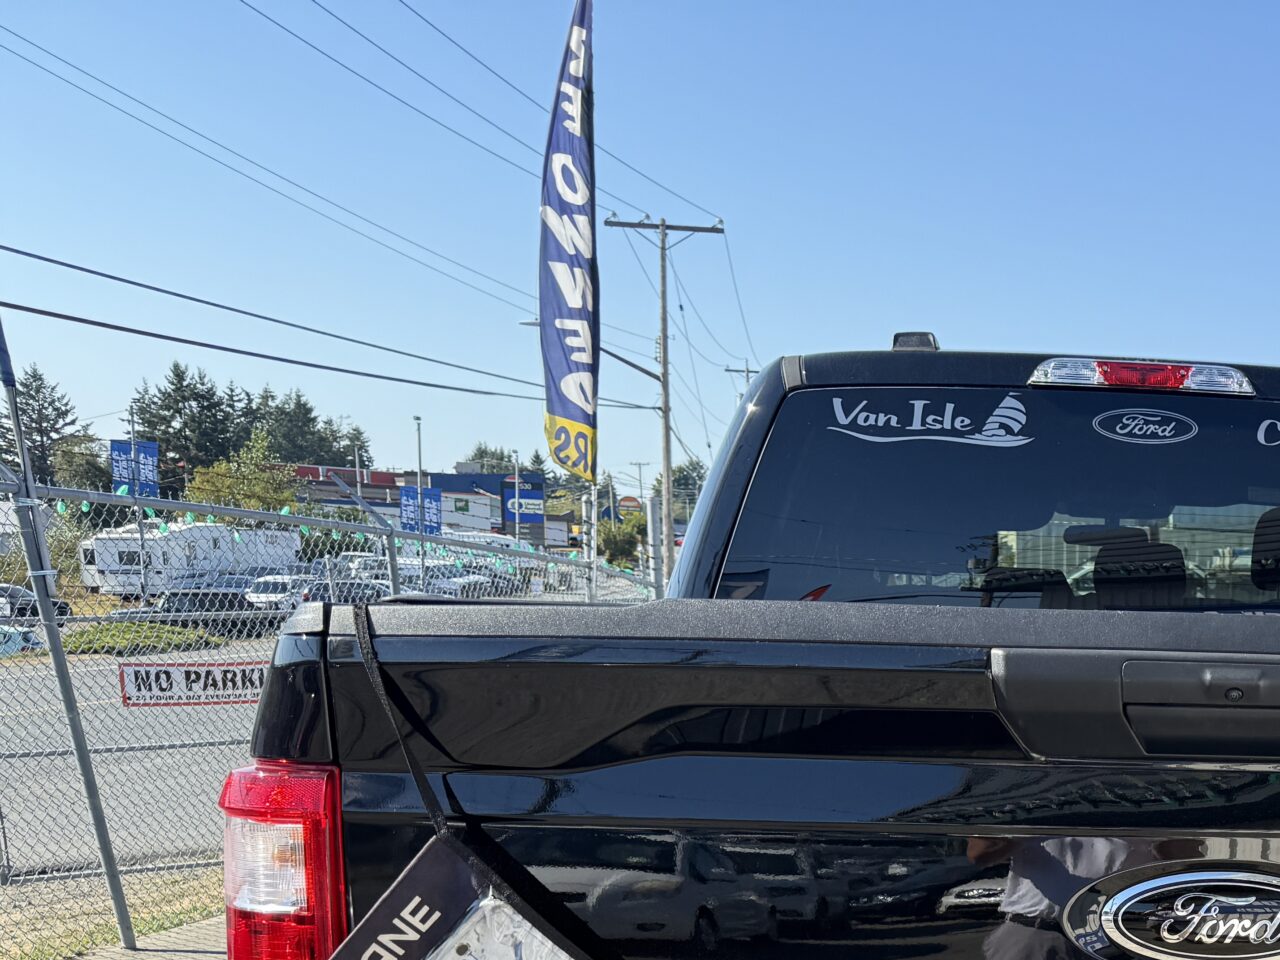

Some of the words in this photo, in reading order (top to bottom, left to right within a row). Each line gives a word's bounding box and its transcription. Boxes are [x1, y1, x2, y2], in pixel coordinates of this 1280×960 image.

[832, 398, 901, 427] Van
[905, 400, 975, 431] Isle
[1115, 413, 1176, 438] Ford
[134, 669, 174, 692] NO
